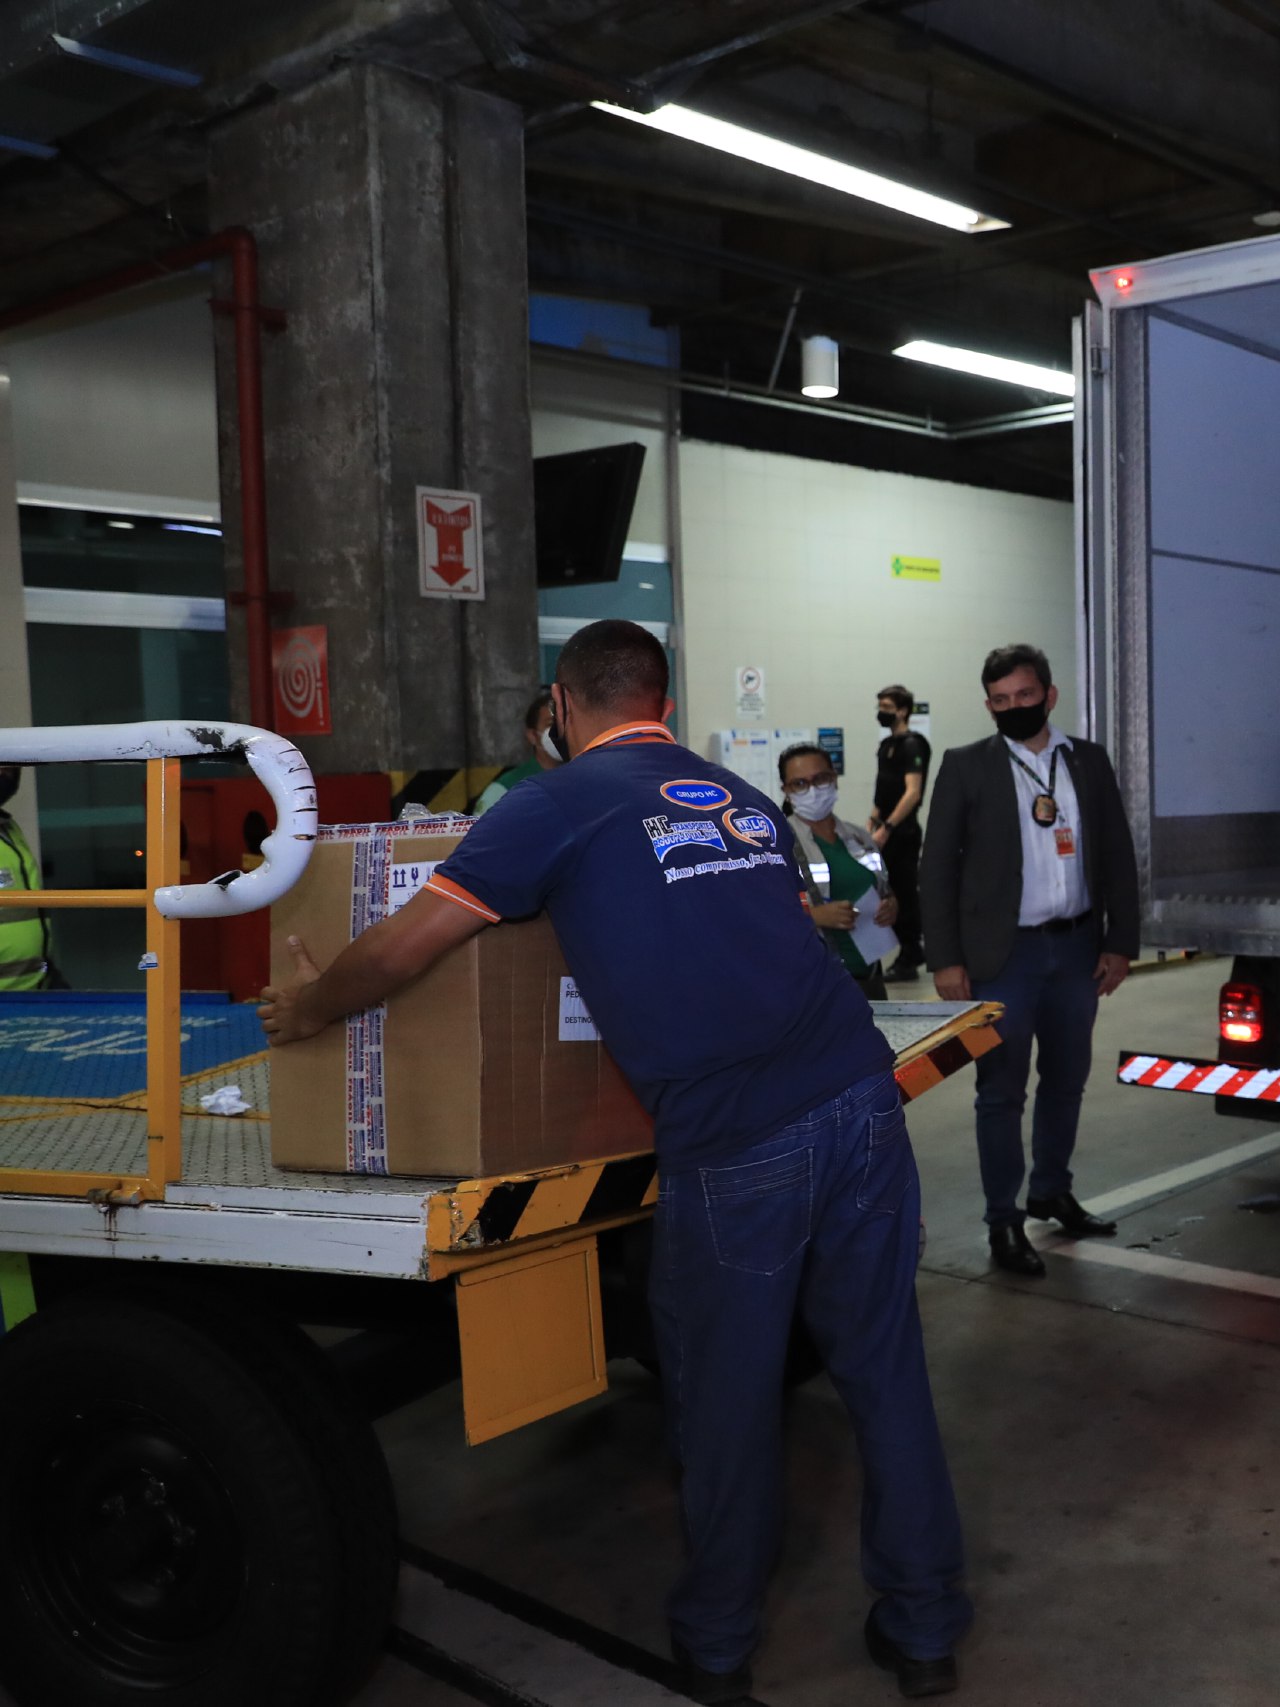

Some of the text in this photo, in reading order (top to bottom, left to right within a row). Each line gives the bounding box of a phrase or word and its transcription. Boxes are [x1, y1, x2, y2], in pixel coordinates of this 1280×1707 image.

[676, 789, 719, 798] GRUPO HC
[664, 866, 694, 884] Nosso
